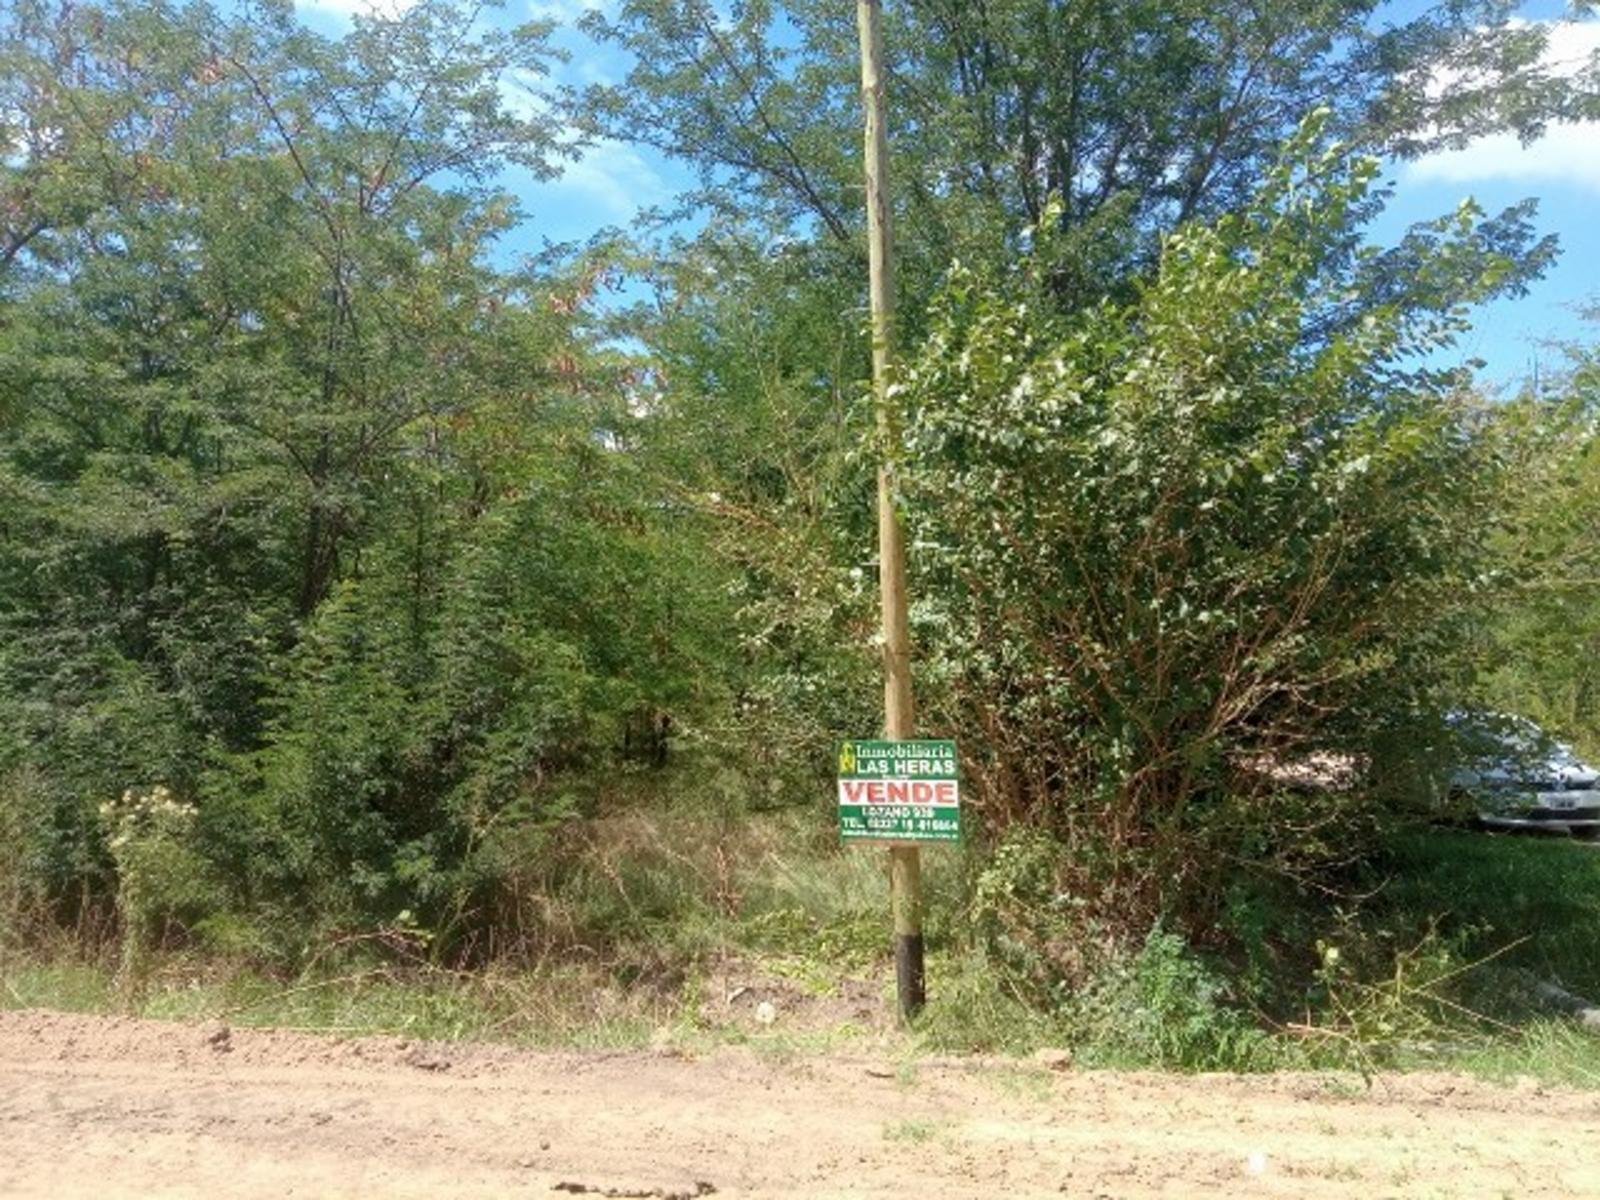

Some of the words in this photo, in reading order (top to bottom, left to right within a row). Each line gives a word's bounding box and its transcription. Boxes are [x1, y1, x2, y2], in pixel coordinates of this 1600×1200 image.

[856, 744, 953, 758] Inmobiliaria
[857, 760, 888, 774] LAS
[894, 760, 955, 774] HERAS
[843, 782, 955, 803] VENDE
